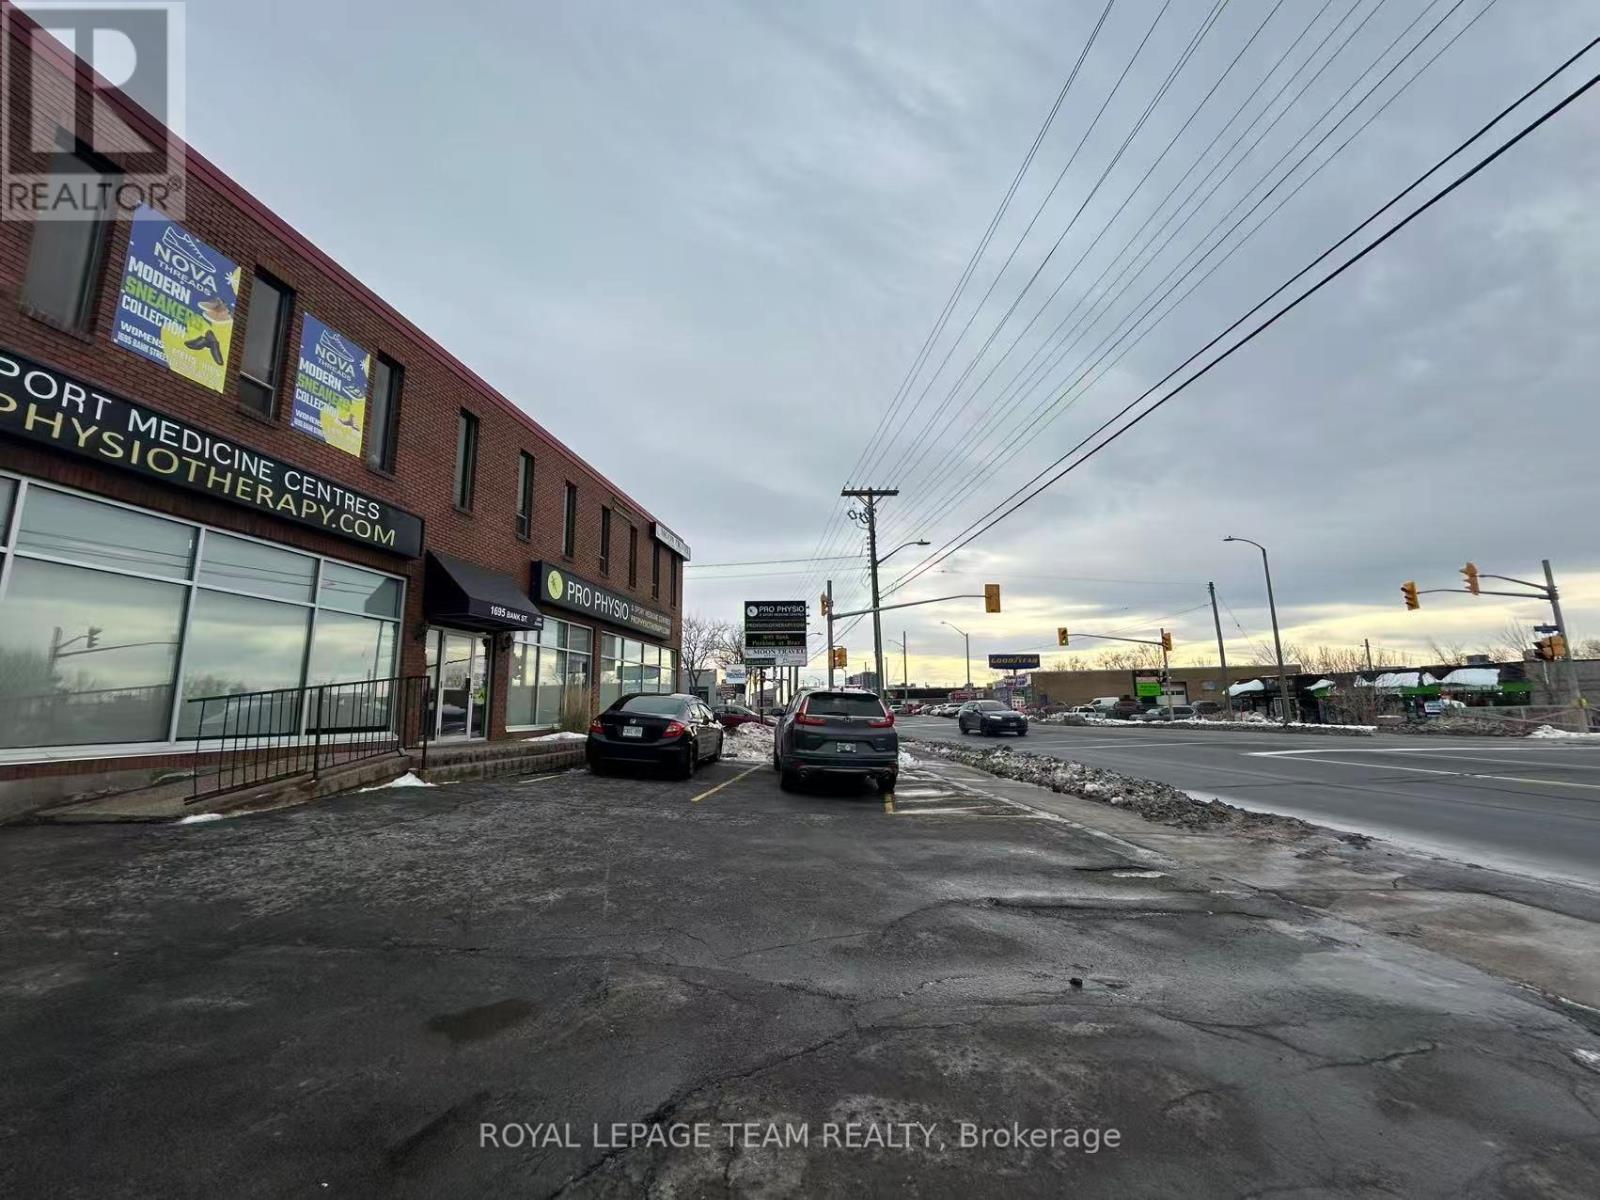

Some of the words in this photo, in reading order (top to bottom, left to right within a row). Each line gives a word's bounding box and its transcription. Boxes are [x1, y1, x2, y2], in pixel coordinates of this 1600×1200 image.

[128, 255, 192, 305] MODERN
[154, 241, 223, 293] NOVA
[158, 259, 212, 297] THREADS
[121, 294, 187, 338] COLLECTION
[125, 275, 204, 332] SNEAKERS
[120, 321, 166, 349] WOMENS
[299, 357, 342, 392] MODERN
[315, 343, 356, 378] NOVA
[127, 408, 275, 483] MEDICINE
[284, 470, 381, 520] CENTRES
[491, 605, 506, 617] 1695
[506, 610, 521, 621] BANK
[567, 581, 592, 608] PRO
[594, 591, 629, 621] PHYSIO
[759, 605, 775, 613] PRO
[777, 605, 805, 613] PHYSIO
[990, 656, 1039, 665] GOODYEAR
